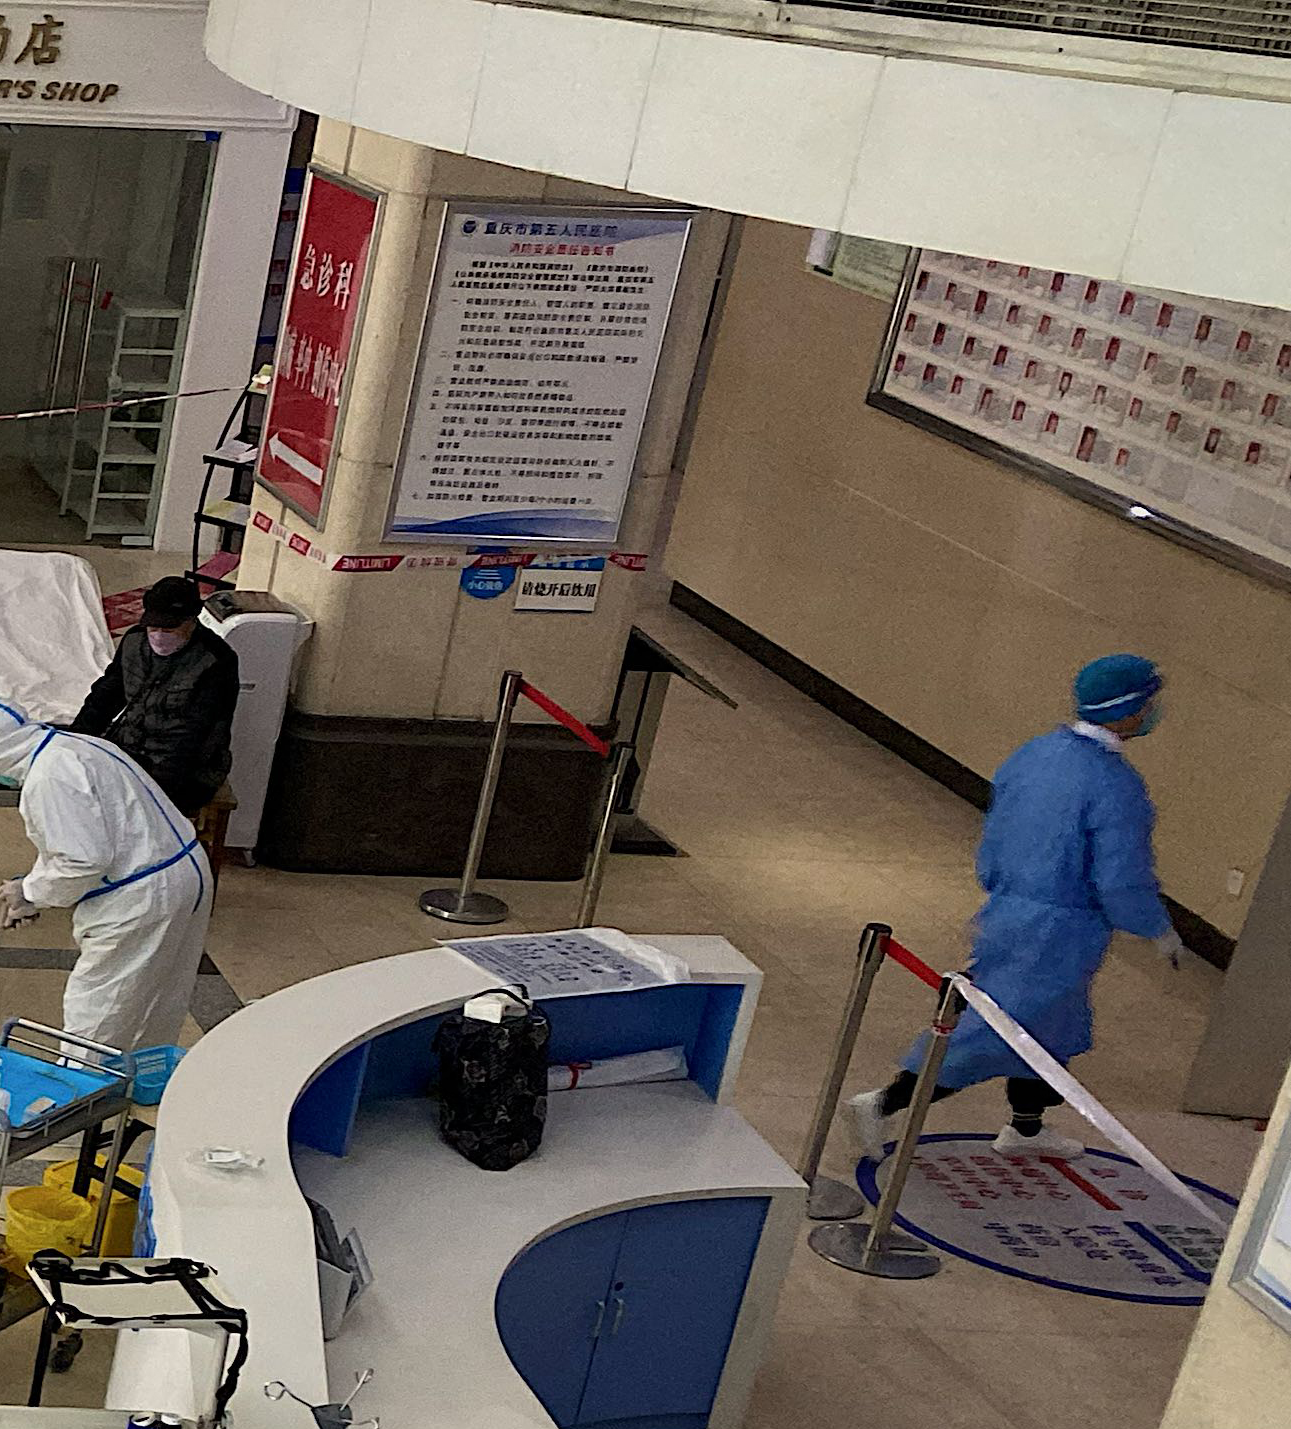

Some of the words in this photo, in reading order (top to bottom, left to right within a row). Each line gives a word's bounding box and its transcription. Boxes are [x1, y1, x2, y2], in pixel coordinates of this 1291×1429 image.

[41, 81, 120, 104] SHOP
[300, 243, 354, 311] 急诊科
[341, 555, 394, 571] LIMITLINE
